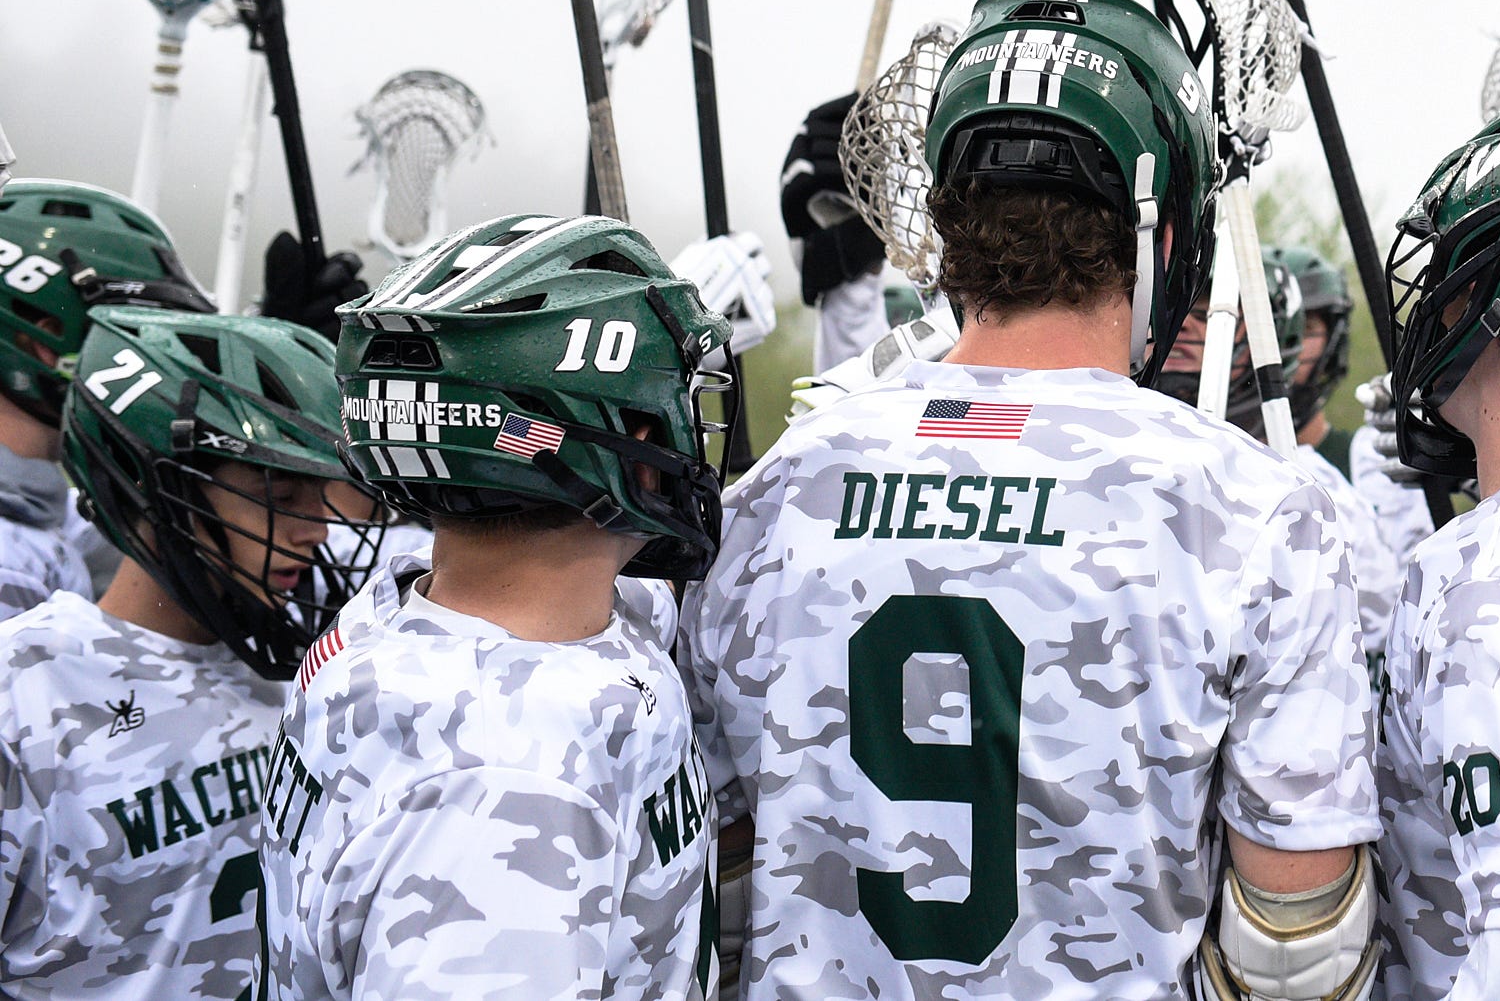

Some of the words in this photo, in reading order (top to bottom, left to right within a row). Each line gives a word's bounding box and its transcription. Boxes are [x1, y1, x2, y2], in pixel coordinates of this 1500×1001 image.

[959, 41, 1119, 80] MOUNTAINEERS
[554, 318, 637, 373] 10
[85, 348, 163, 415] 21
[343, 395, 501, 428] MOUNTAINEERS
[834, 472, 1066, 547] DIESEL
[108, 707, 146, 738] AS
[848, 594, 1026, 966] 9
